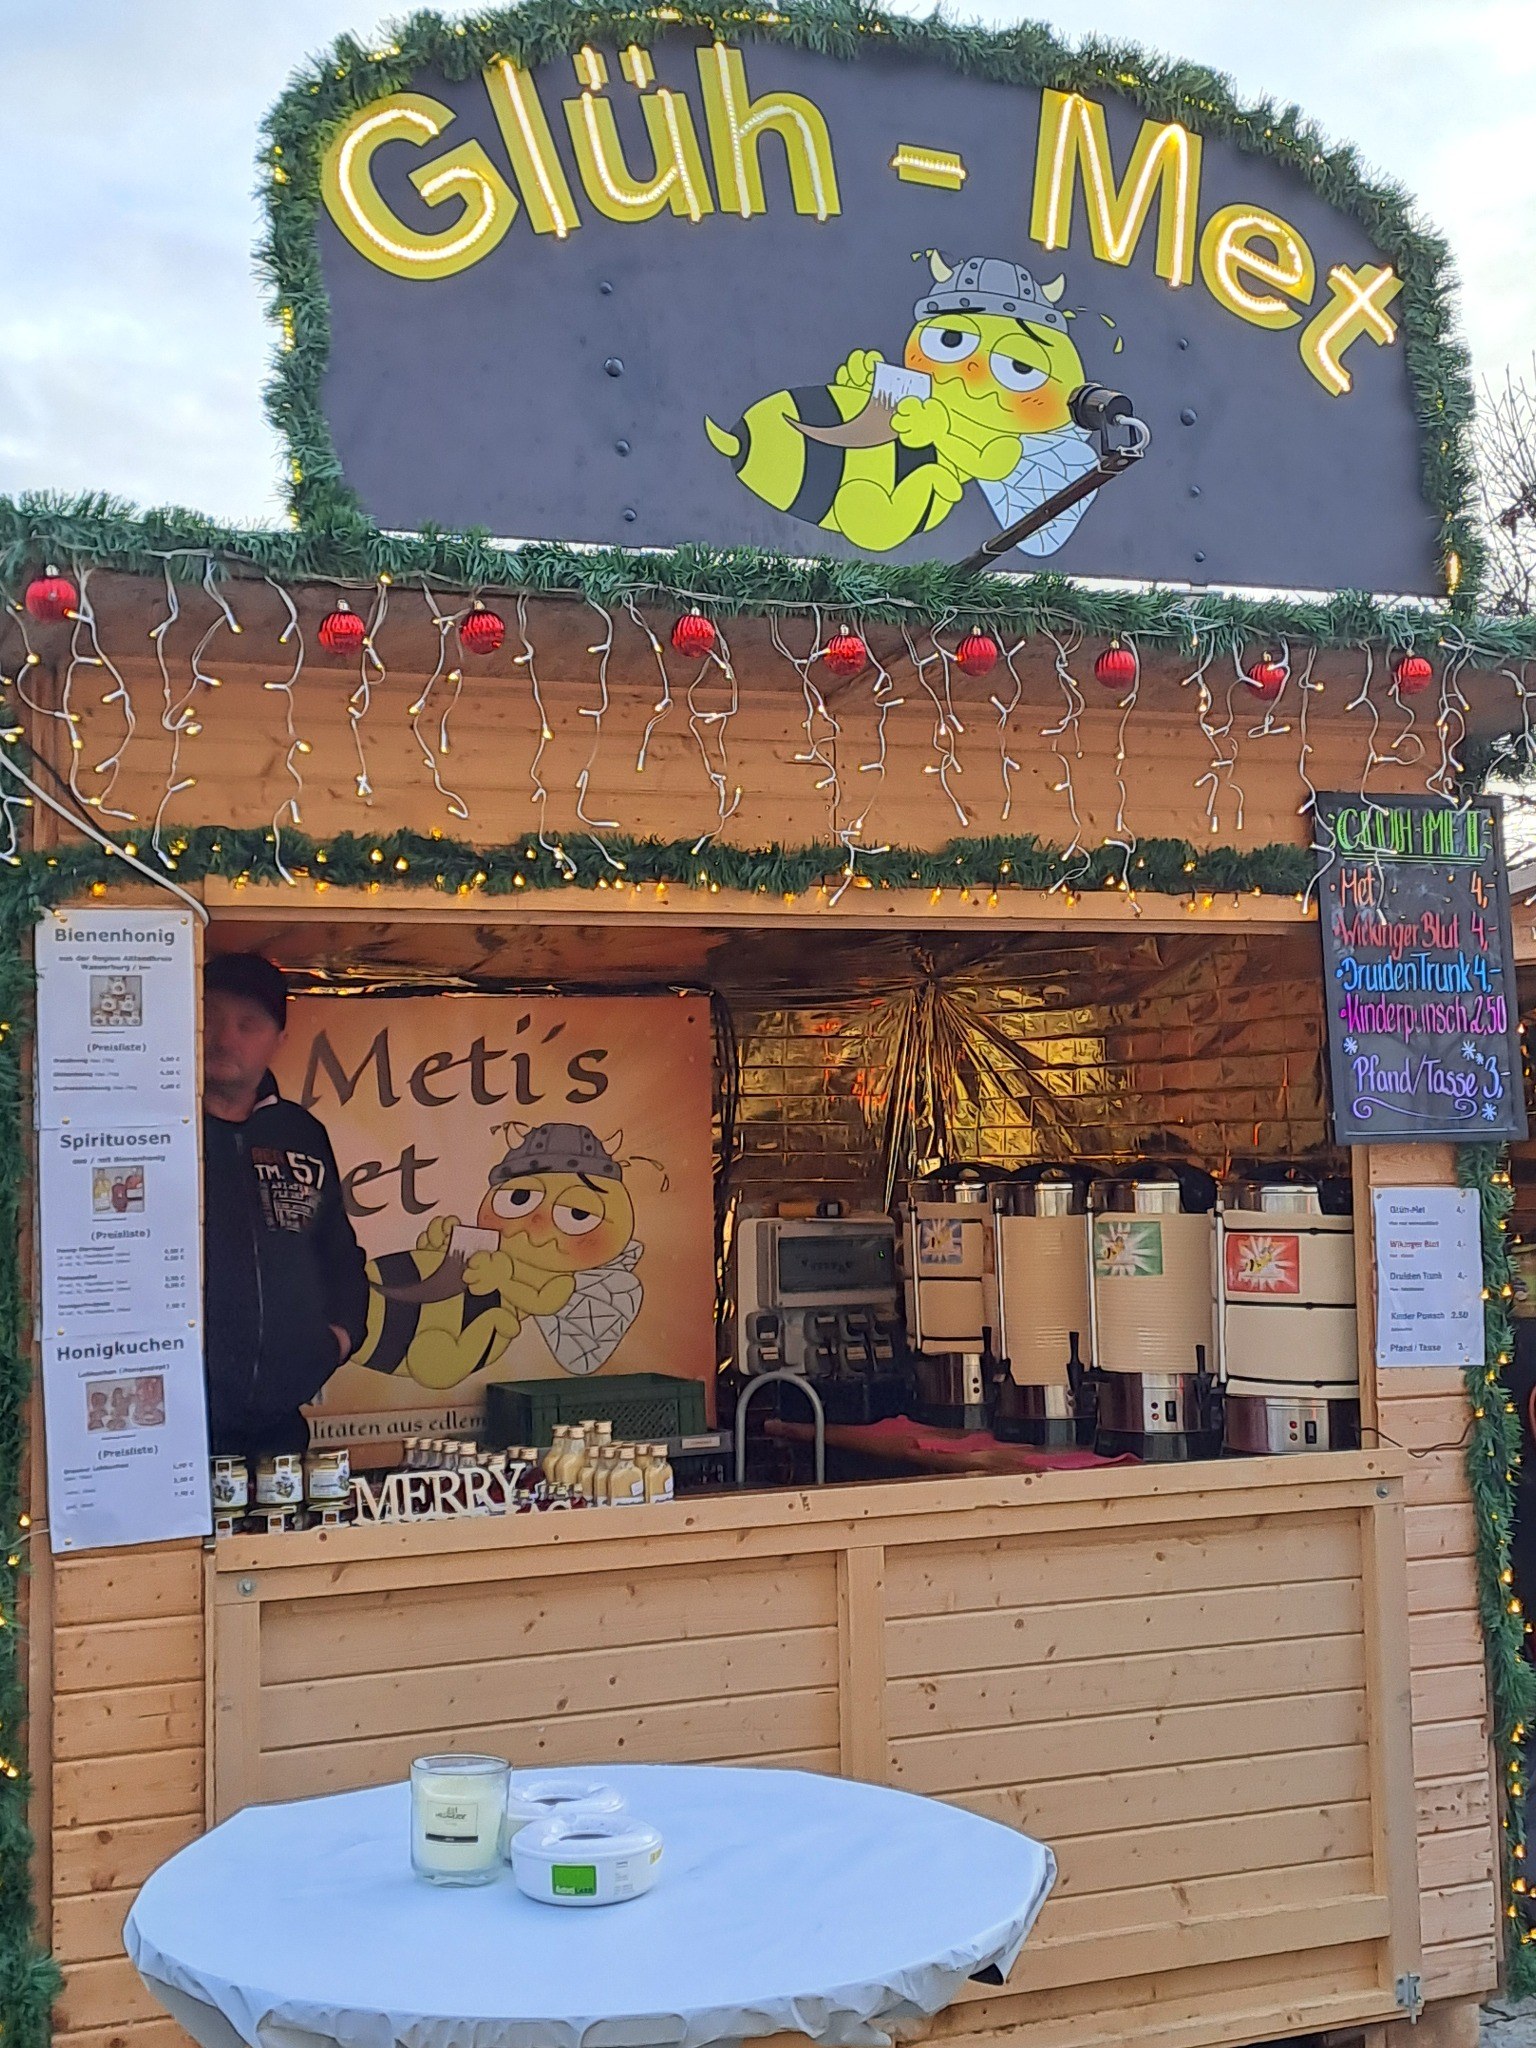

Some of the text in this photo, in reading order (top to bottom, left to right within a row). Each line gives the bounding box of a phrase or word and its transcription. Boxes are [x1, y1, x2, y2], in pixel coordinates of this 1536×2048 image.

[320, 41, 842, 280] Glüh
[1029, 87, 1404, 397] Met
[1340, 867, 1377, 908] Met
[55, 928, 176, 946] Bienenhonig
[1420, 911, 1460, 949] Blut
[1410, 951, 1473, 993] Trunk
[1470, 994, 1507, 1036] 2,50
[60, 1132, 171, 1151] Spirituosen
[286, 1151, 325, 1190] 57
[341, 1144, 440, 1217] et
[1390, 1272, 1421, 1280] Druiden
[57, 1337, 185, 1362] Honigkuchen
[1390, 1344, 1413, 1352] Pfand
[1419, 1344, 1442, 1352] Tasse
[387, 1417, 424, 1433] aus
[349, 1462, 527, 1527] MERRY
